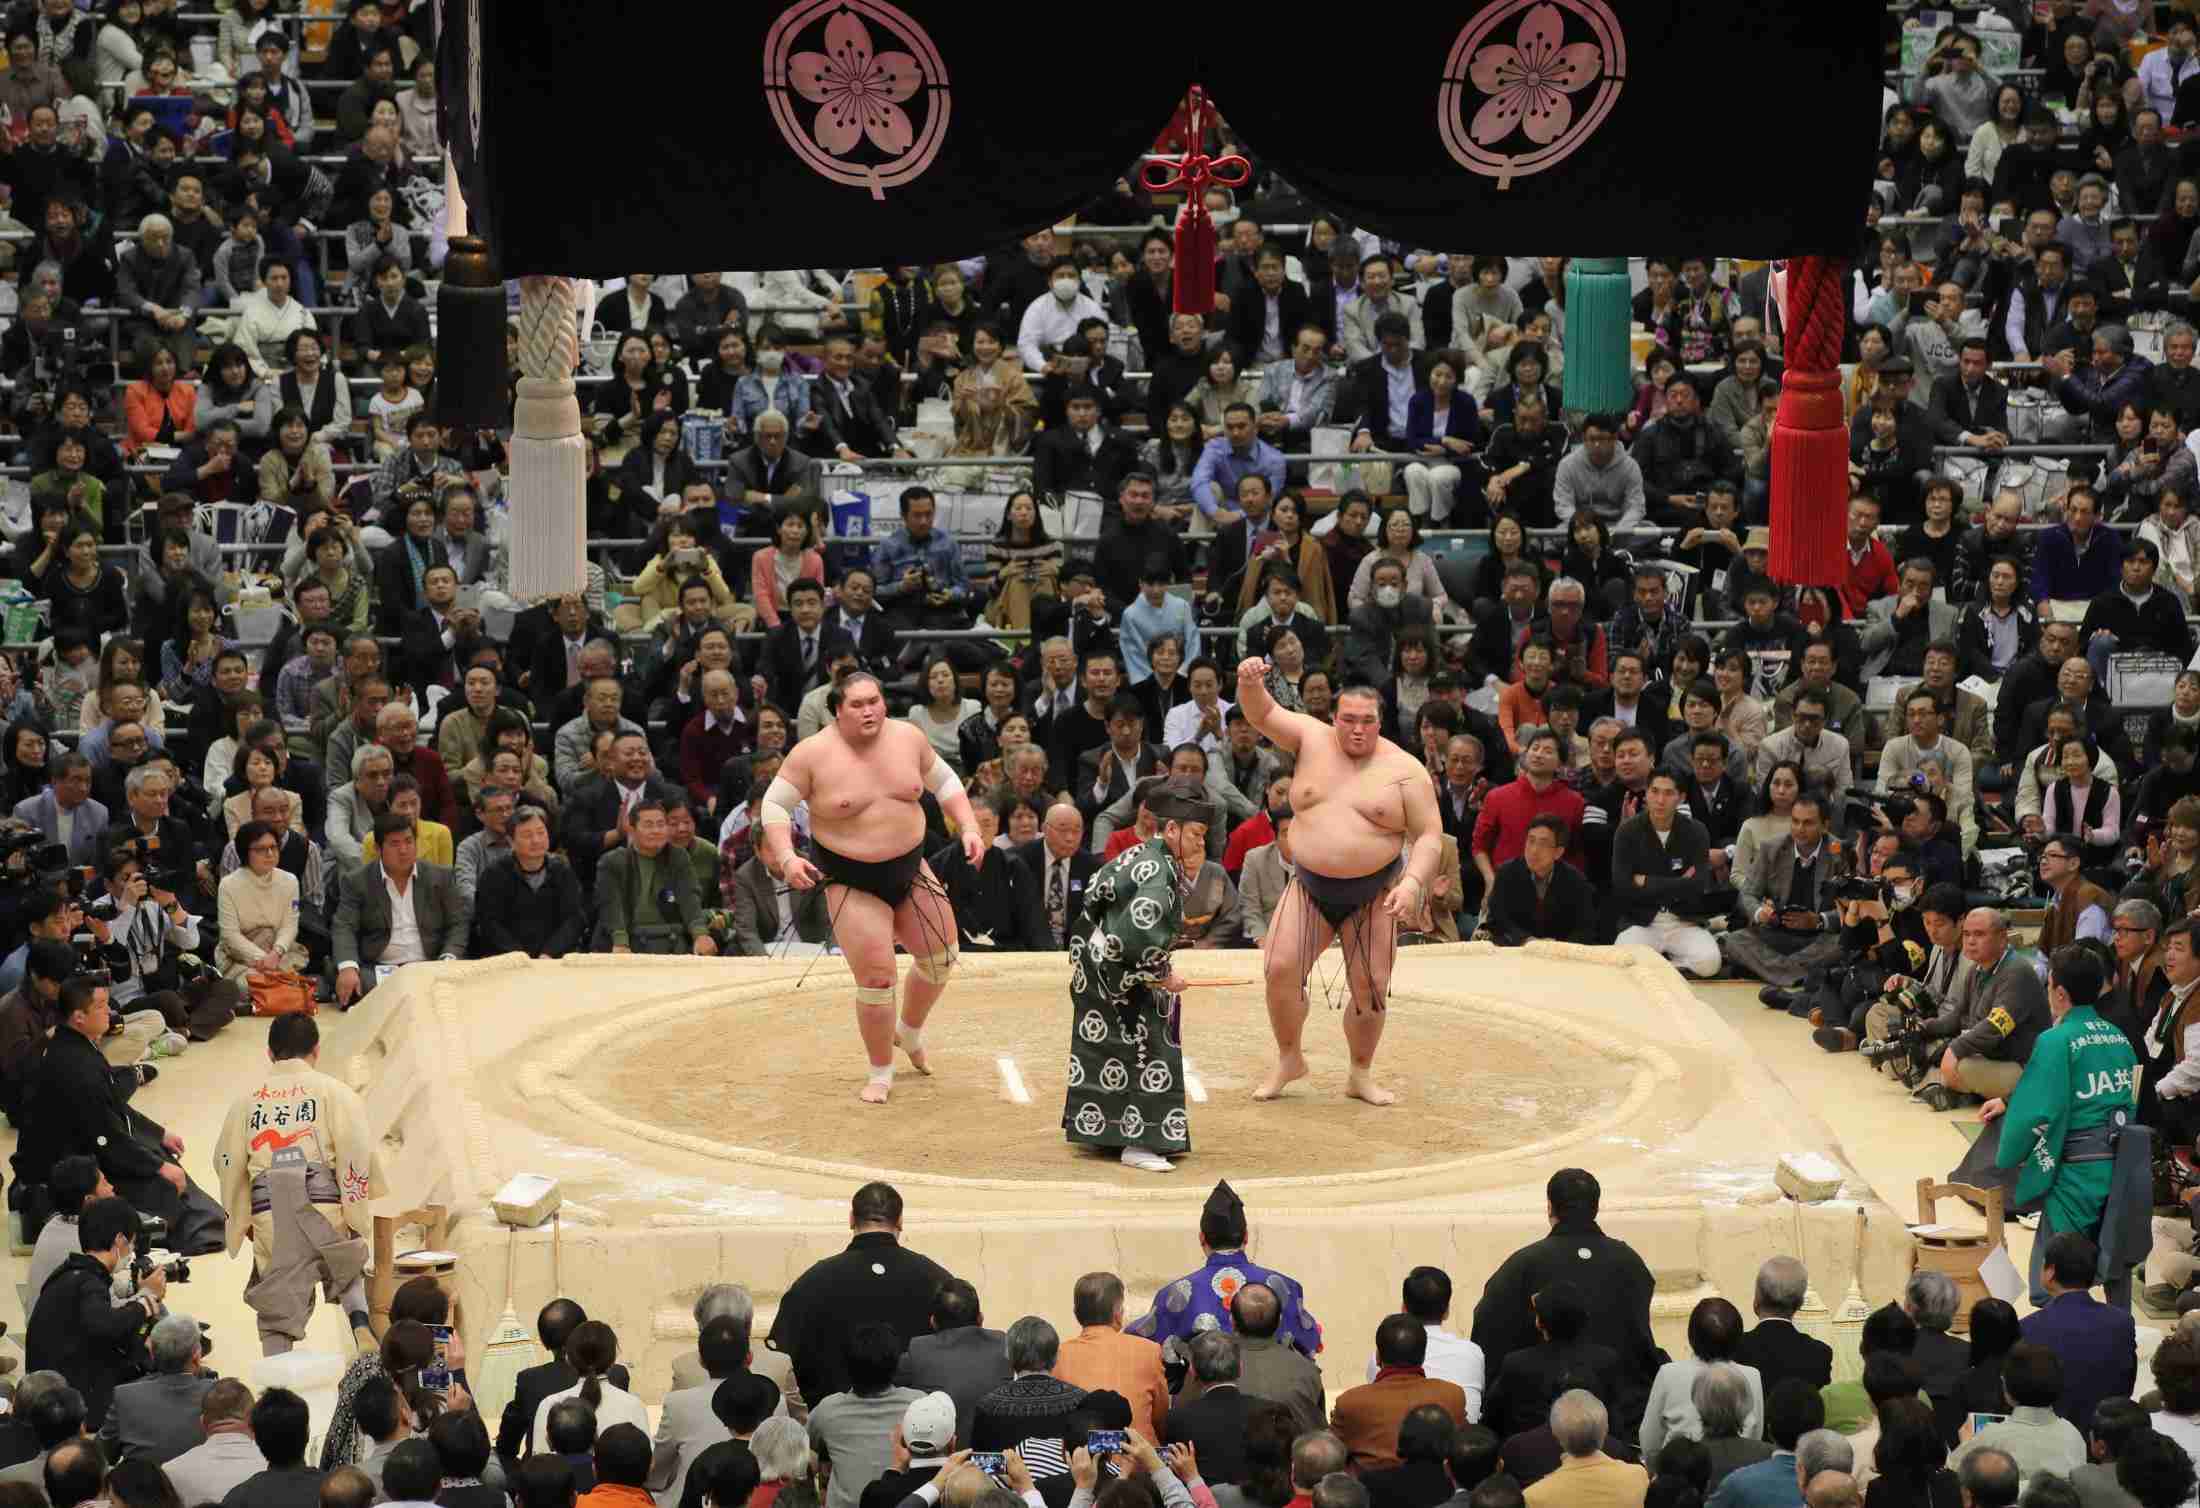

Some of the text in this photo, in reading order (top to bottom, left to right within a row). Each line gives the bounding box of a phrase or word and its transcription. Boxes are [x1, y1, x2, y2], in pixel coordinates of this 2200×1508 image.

[2075, 1069, 2133, 1099] JA共
[249, 1099, 317, 1131] 永谷園
